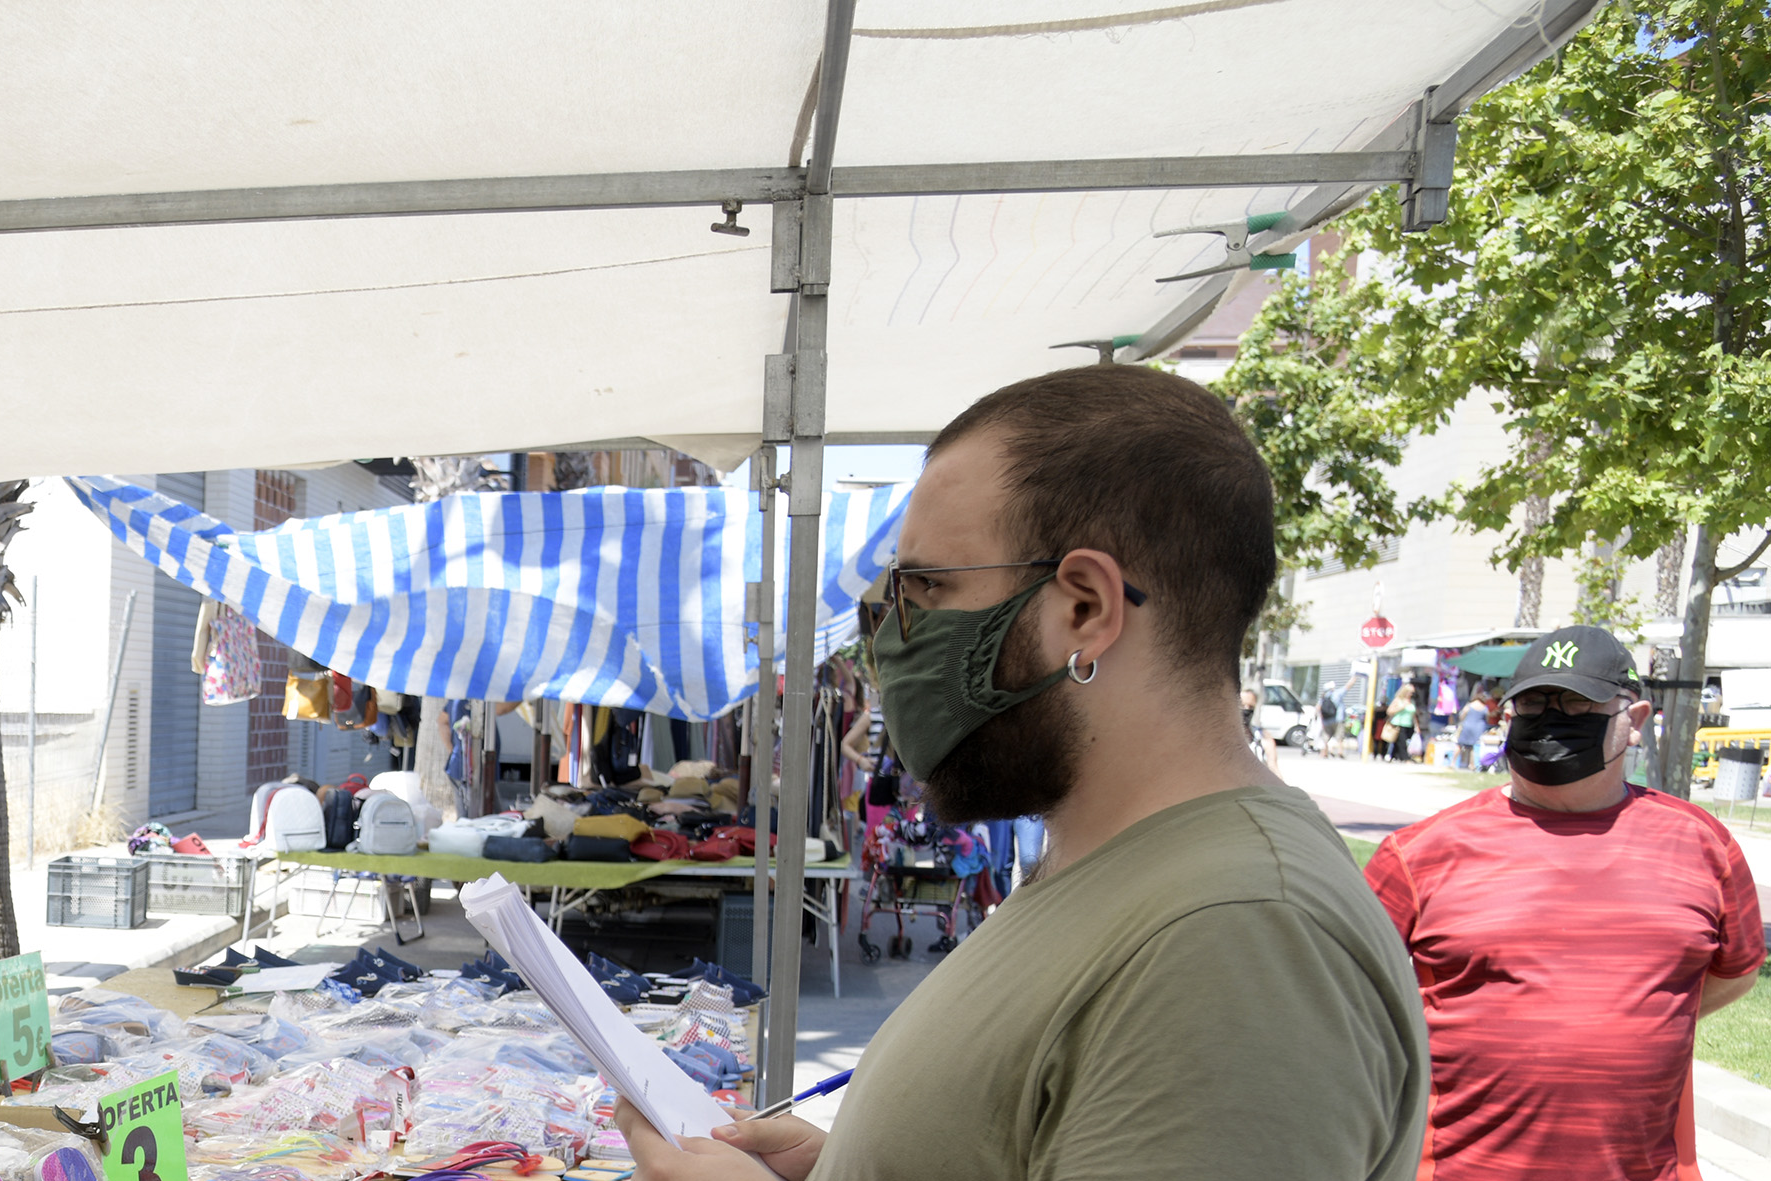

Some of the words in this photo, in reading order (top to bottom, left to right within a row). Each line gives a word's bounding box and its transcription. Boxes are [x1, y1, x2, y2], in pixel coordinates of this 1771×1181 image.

[1361, 626, 1394, 638] STOP
[1541, 641, 1580, 669] NY
[102, 1083, 182, 1131] OFERTA
